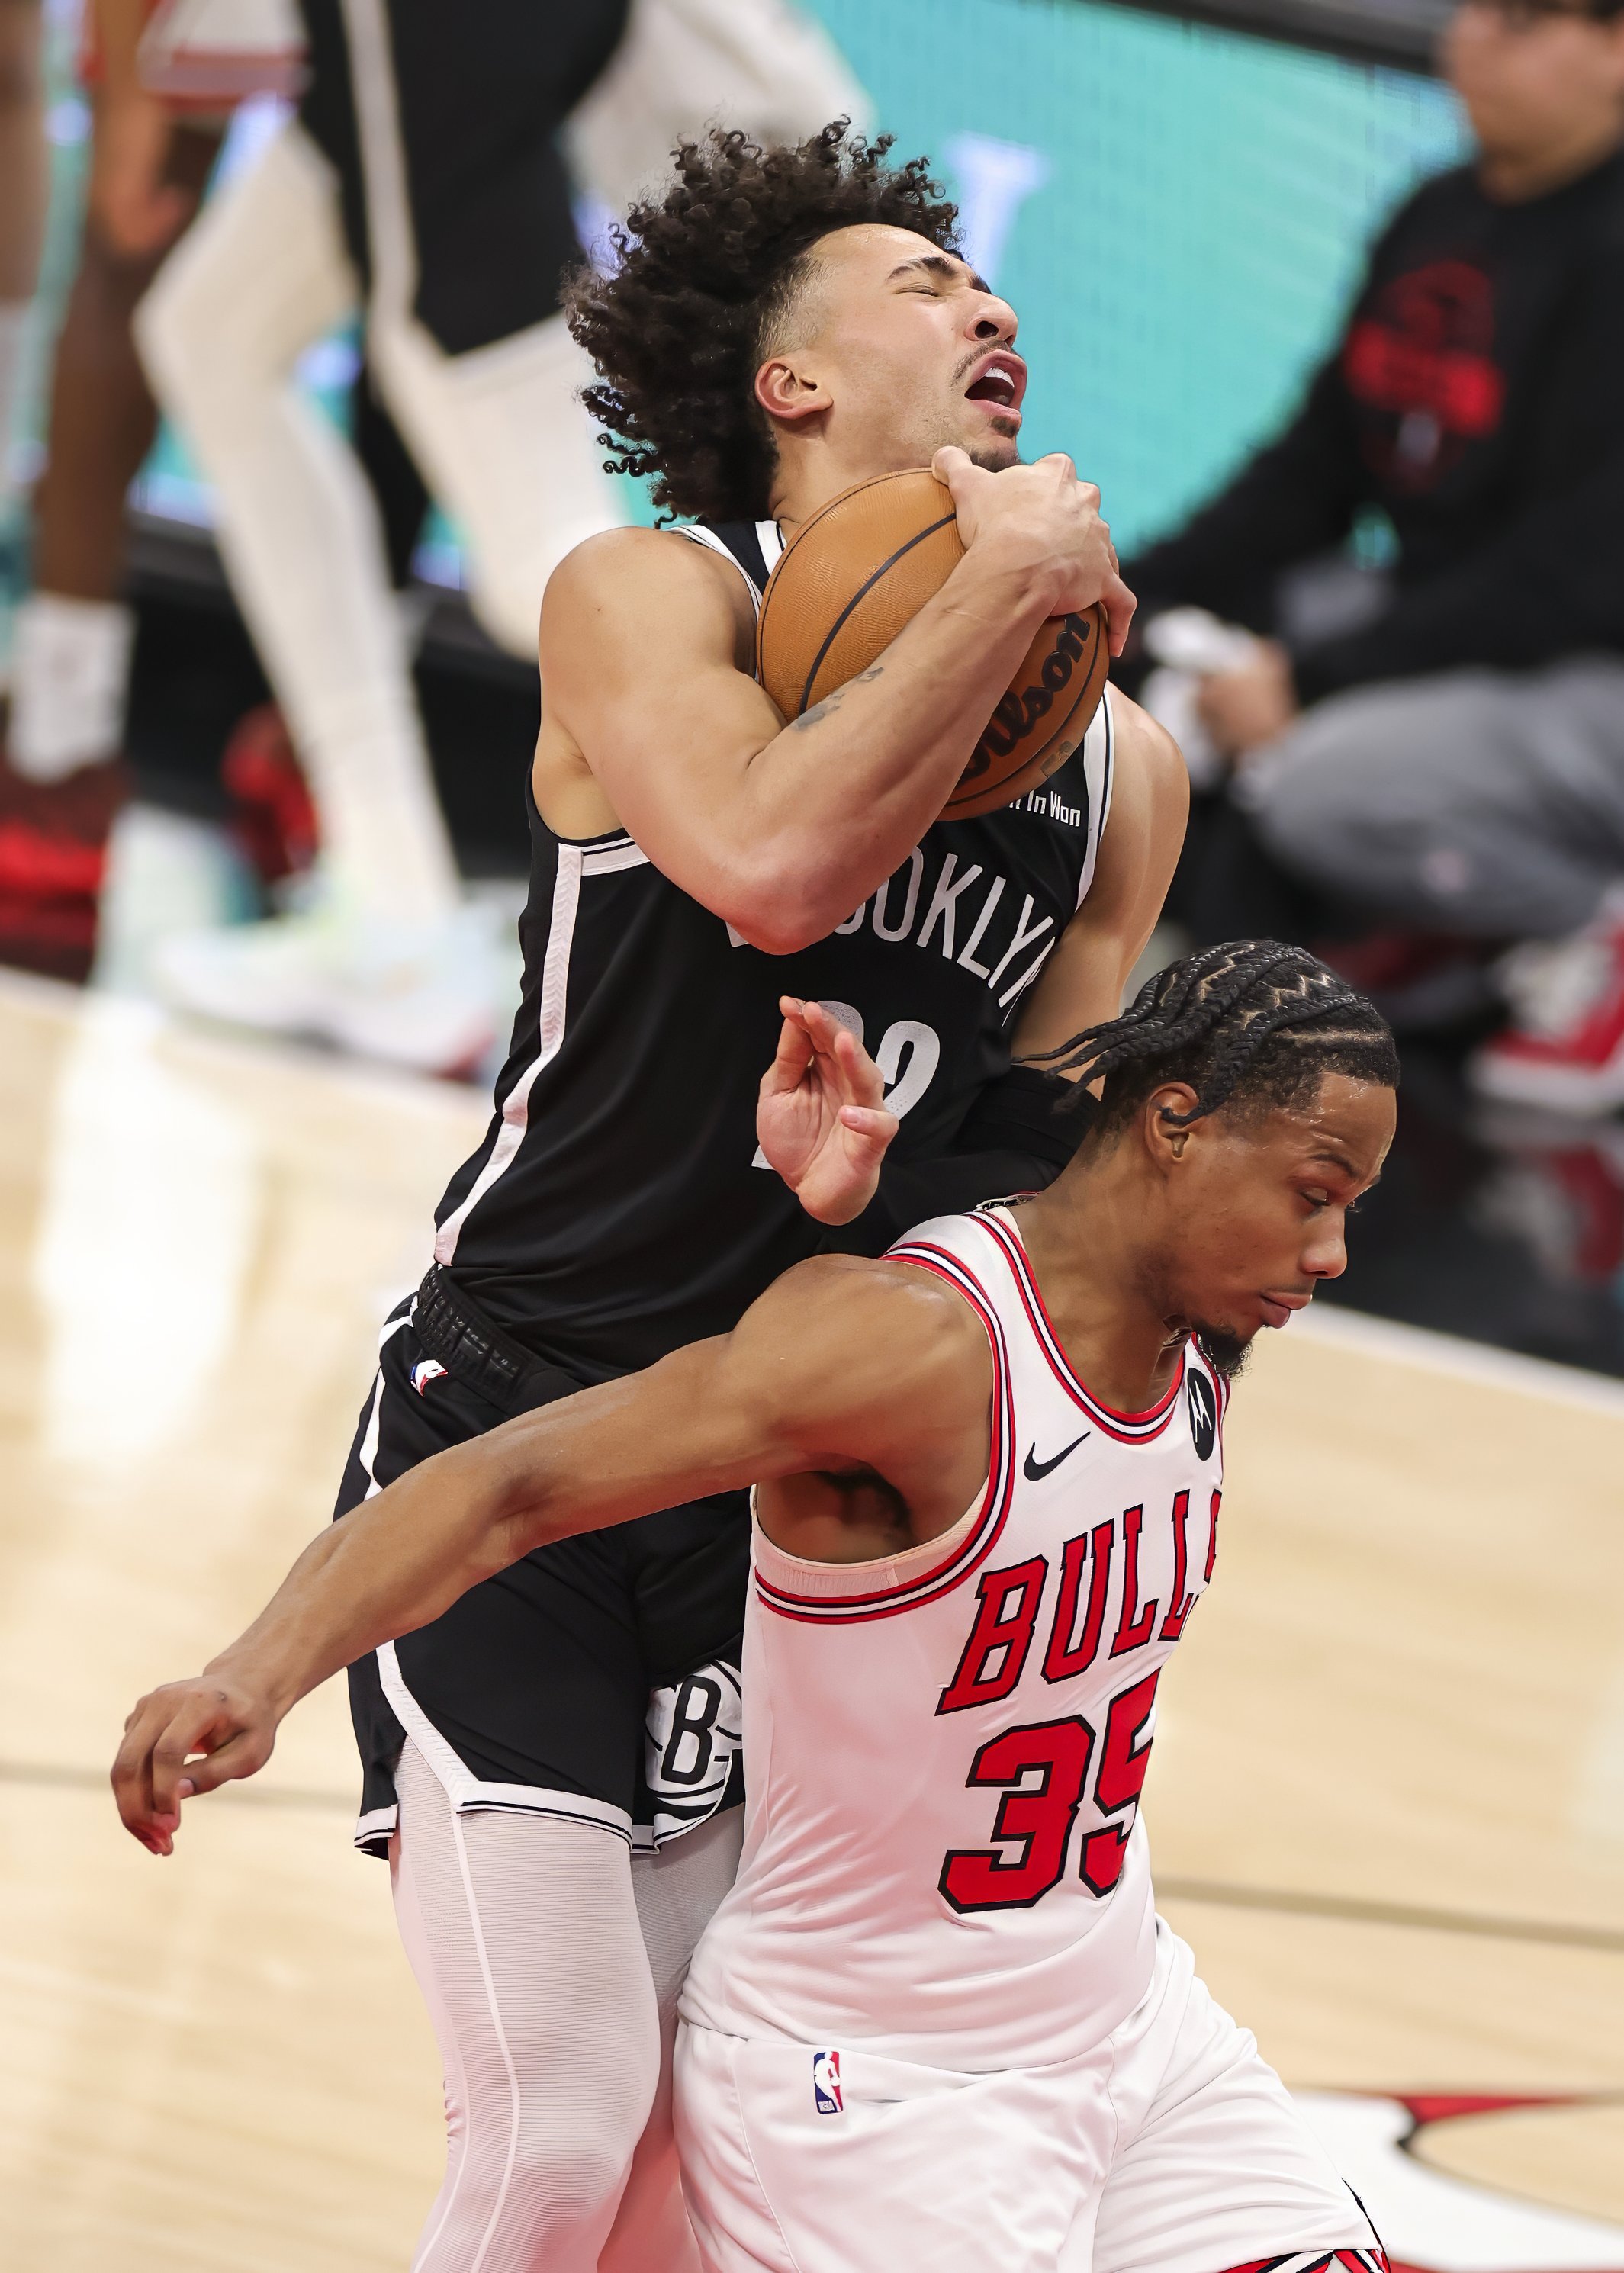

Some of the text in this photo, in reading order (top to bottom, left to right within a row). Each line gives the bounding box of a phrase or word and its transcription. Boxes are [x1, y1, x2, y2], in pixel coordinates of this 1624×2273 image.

[957, 612, 1090, 789] ilson
[1050, 790, 1080, 827] Won
[661, 1675, 721, 1785] B
[937, 1667, 1160, 1914] 35
